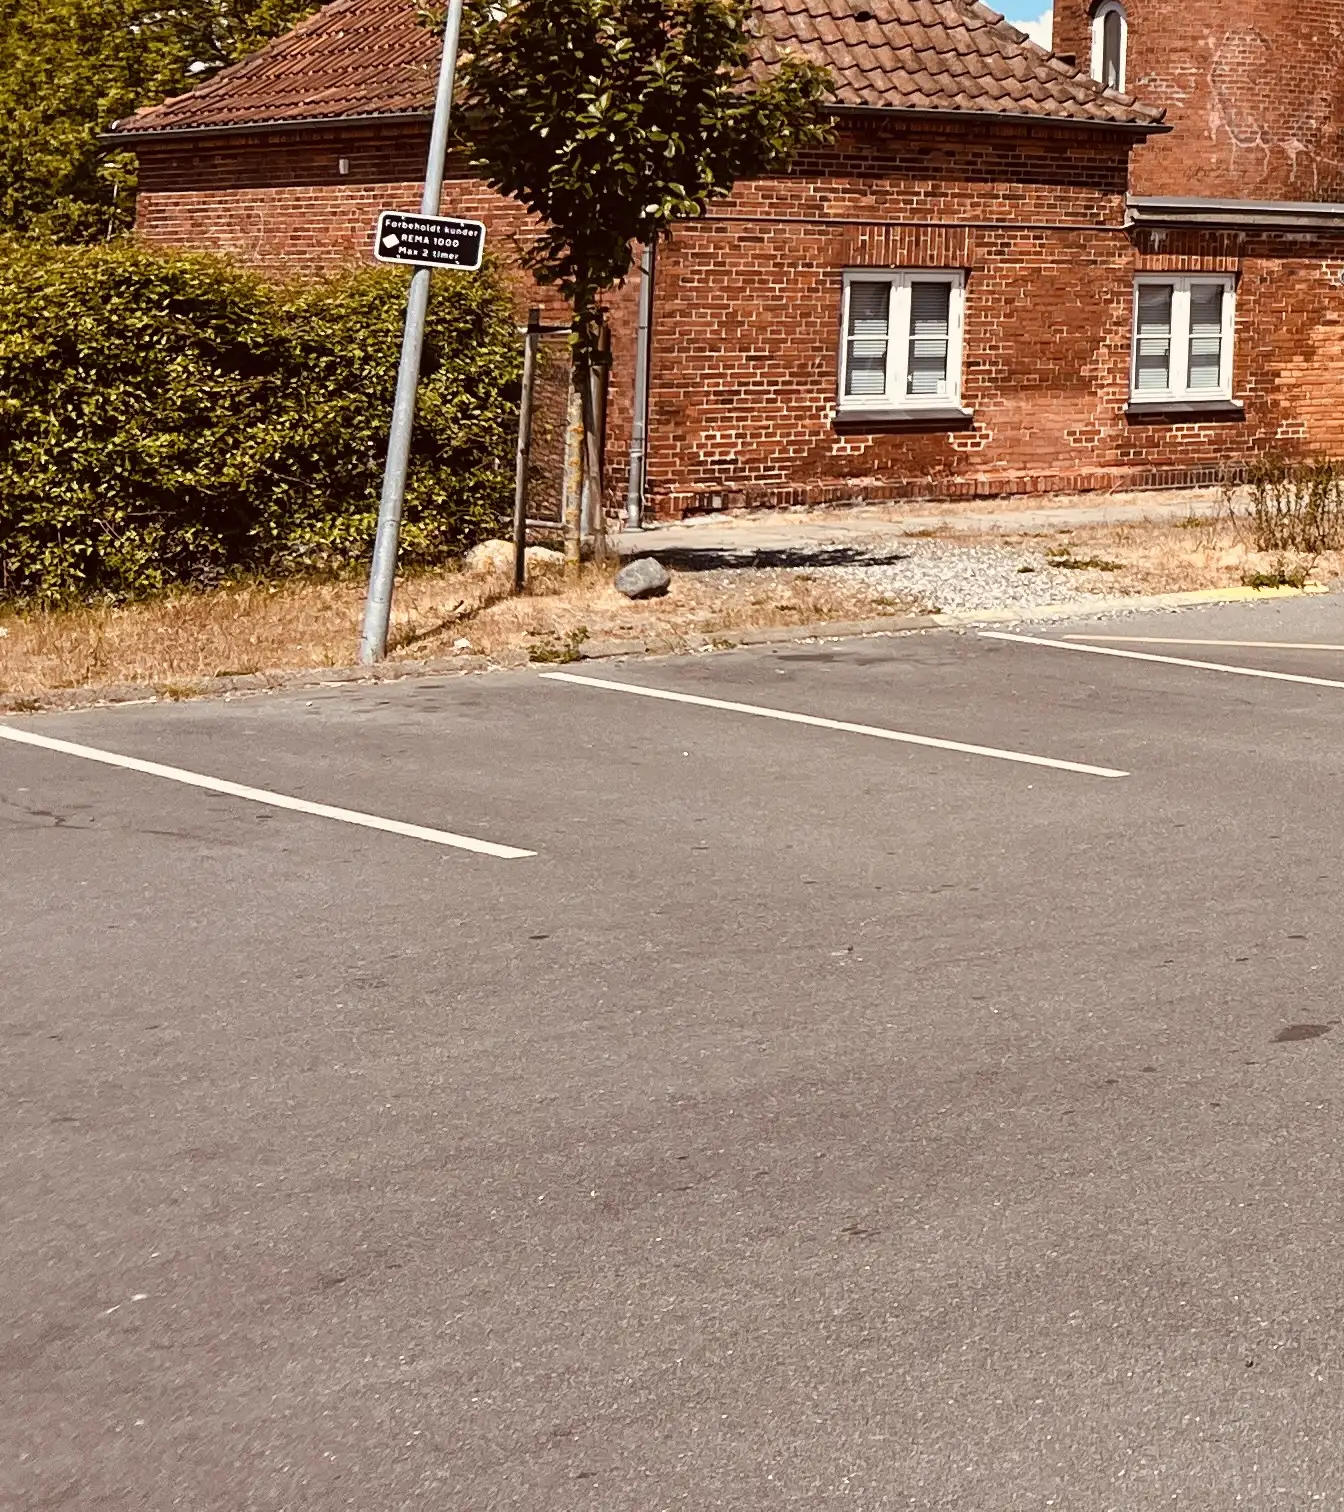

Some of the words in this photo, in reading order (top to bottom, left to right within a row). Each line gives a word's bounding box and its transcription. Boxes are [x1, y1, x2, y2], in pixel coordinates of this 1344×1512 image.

[385, 218, 441, 234] Forbeholdt
[444, 226, 478, 237] kunder
[401, 234, 430, 245] REMA
[433, 237, 460, 248] 1000
[398, 246, 418, 256] Max
[422, 249, 429, 258] 2
[432, 251, 459, 260] timer
